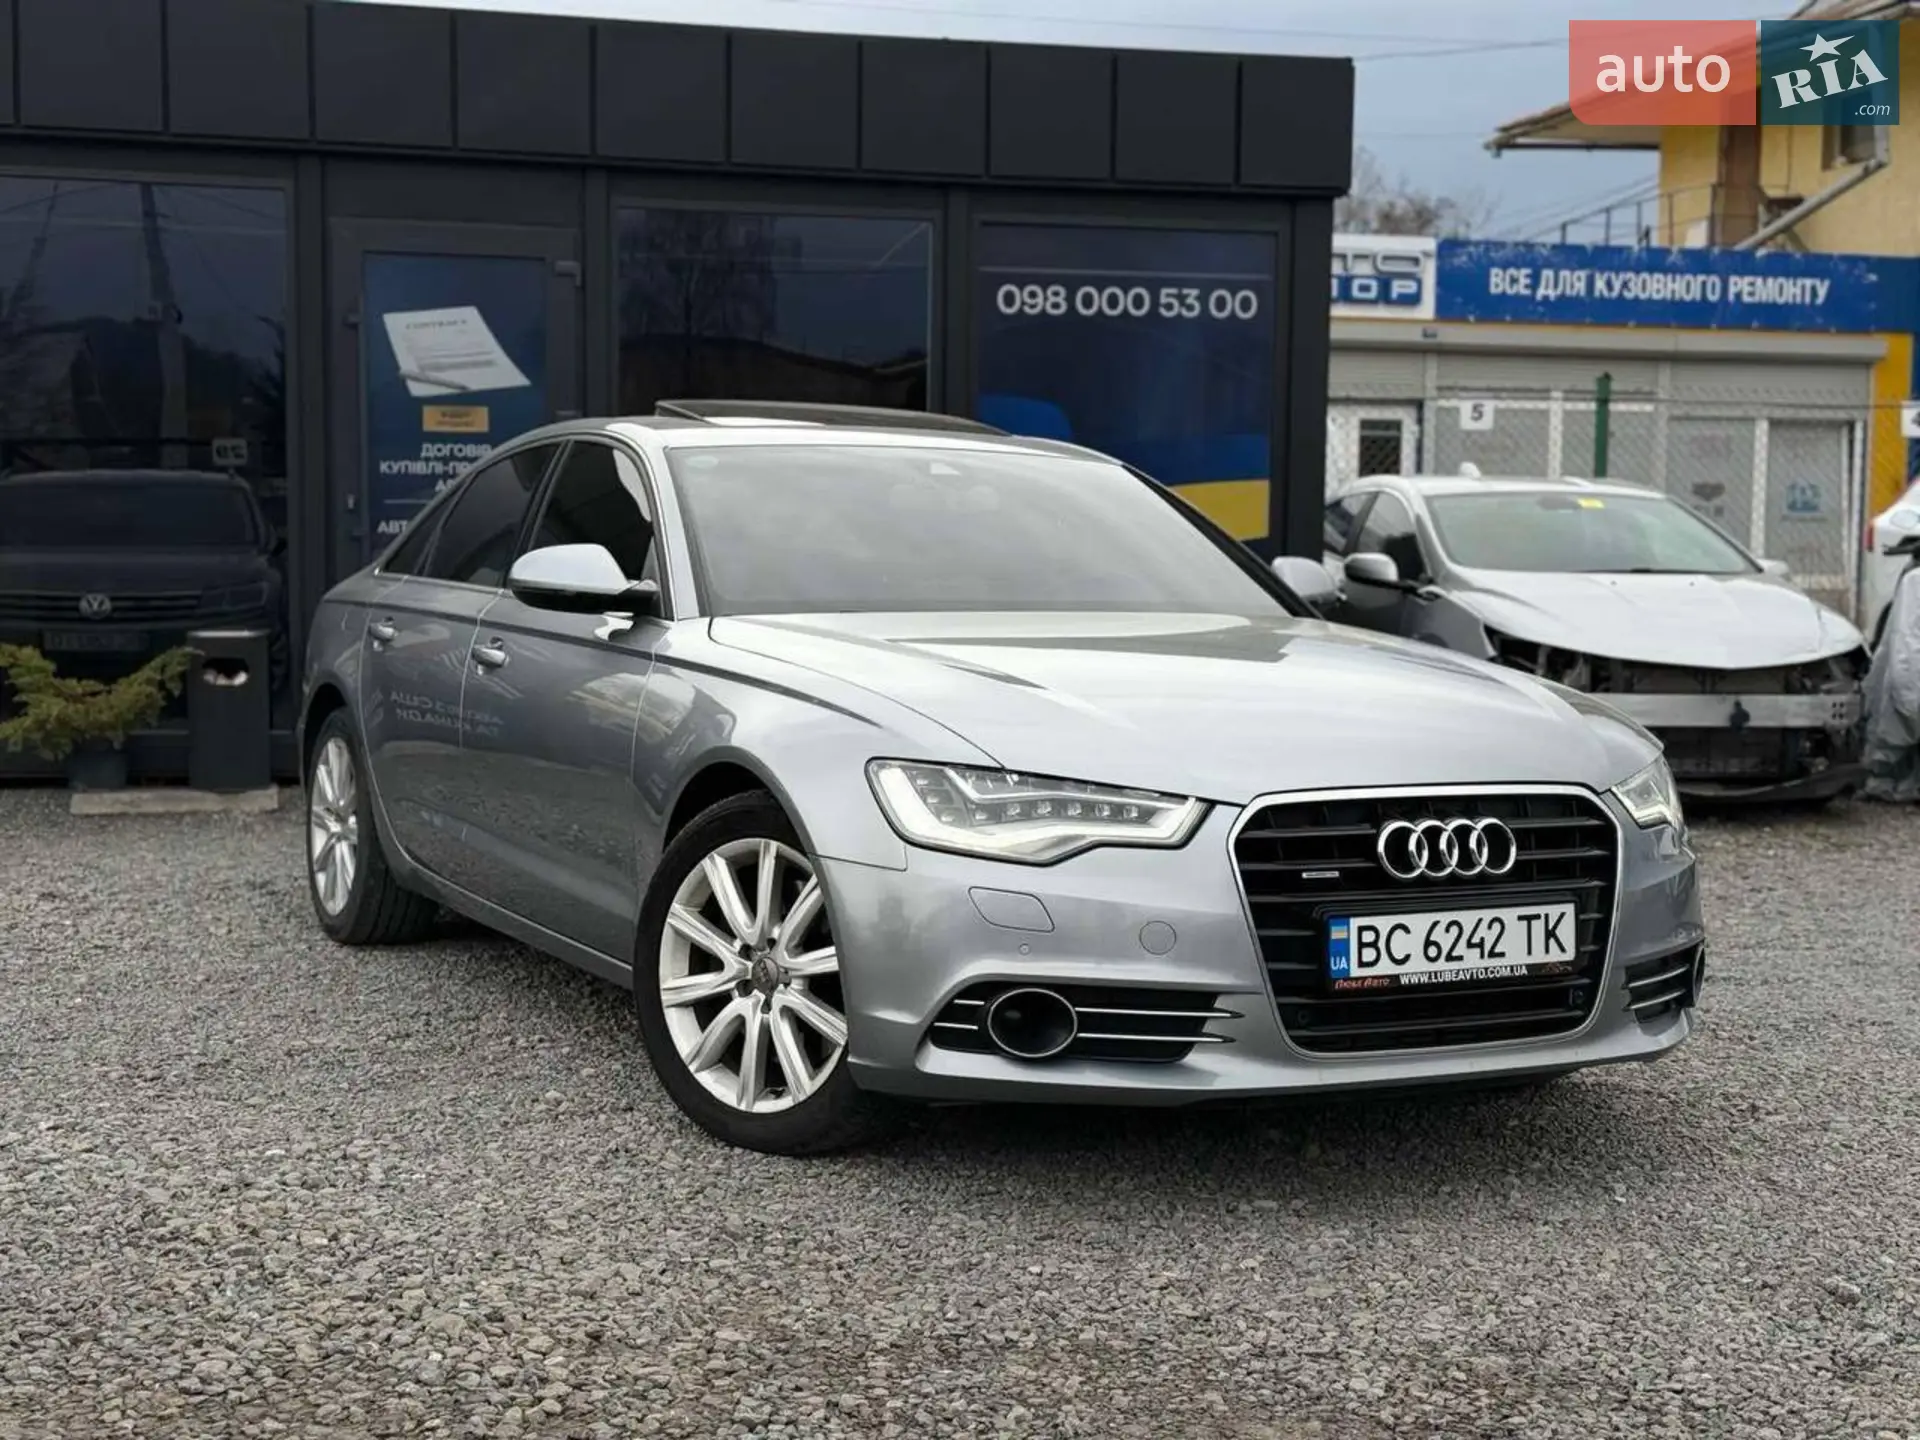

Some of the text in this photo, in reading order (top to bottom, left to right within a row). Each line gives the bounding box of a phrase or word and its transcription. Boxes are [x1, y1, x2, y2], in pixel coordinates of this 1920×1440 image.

[1488, 266, 1831, 306] ВСЕ ДЛЯ КУЗОВНОГО РЕМОНТУ
[996, 283, 1258, 319] 098 000 53 00
[1471, 403, 1485, 421] 5
[377, 520, 408, 534] АВТ
[1356, 911, 1567, 969] BC 6242 TK
[1330, 956, 1348, 971] UA
[1400, 965, 1528, 985] WWW.LUBEAVTO.COM.UA
